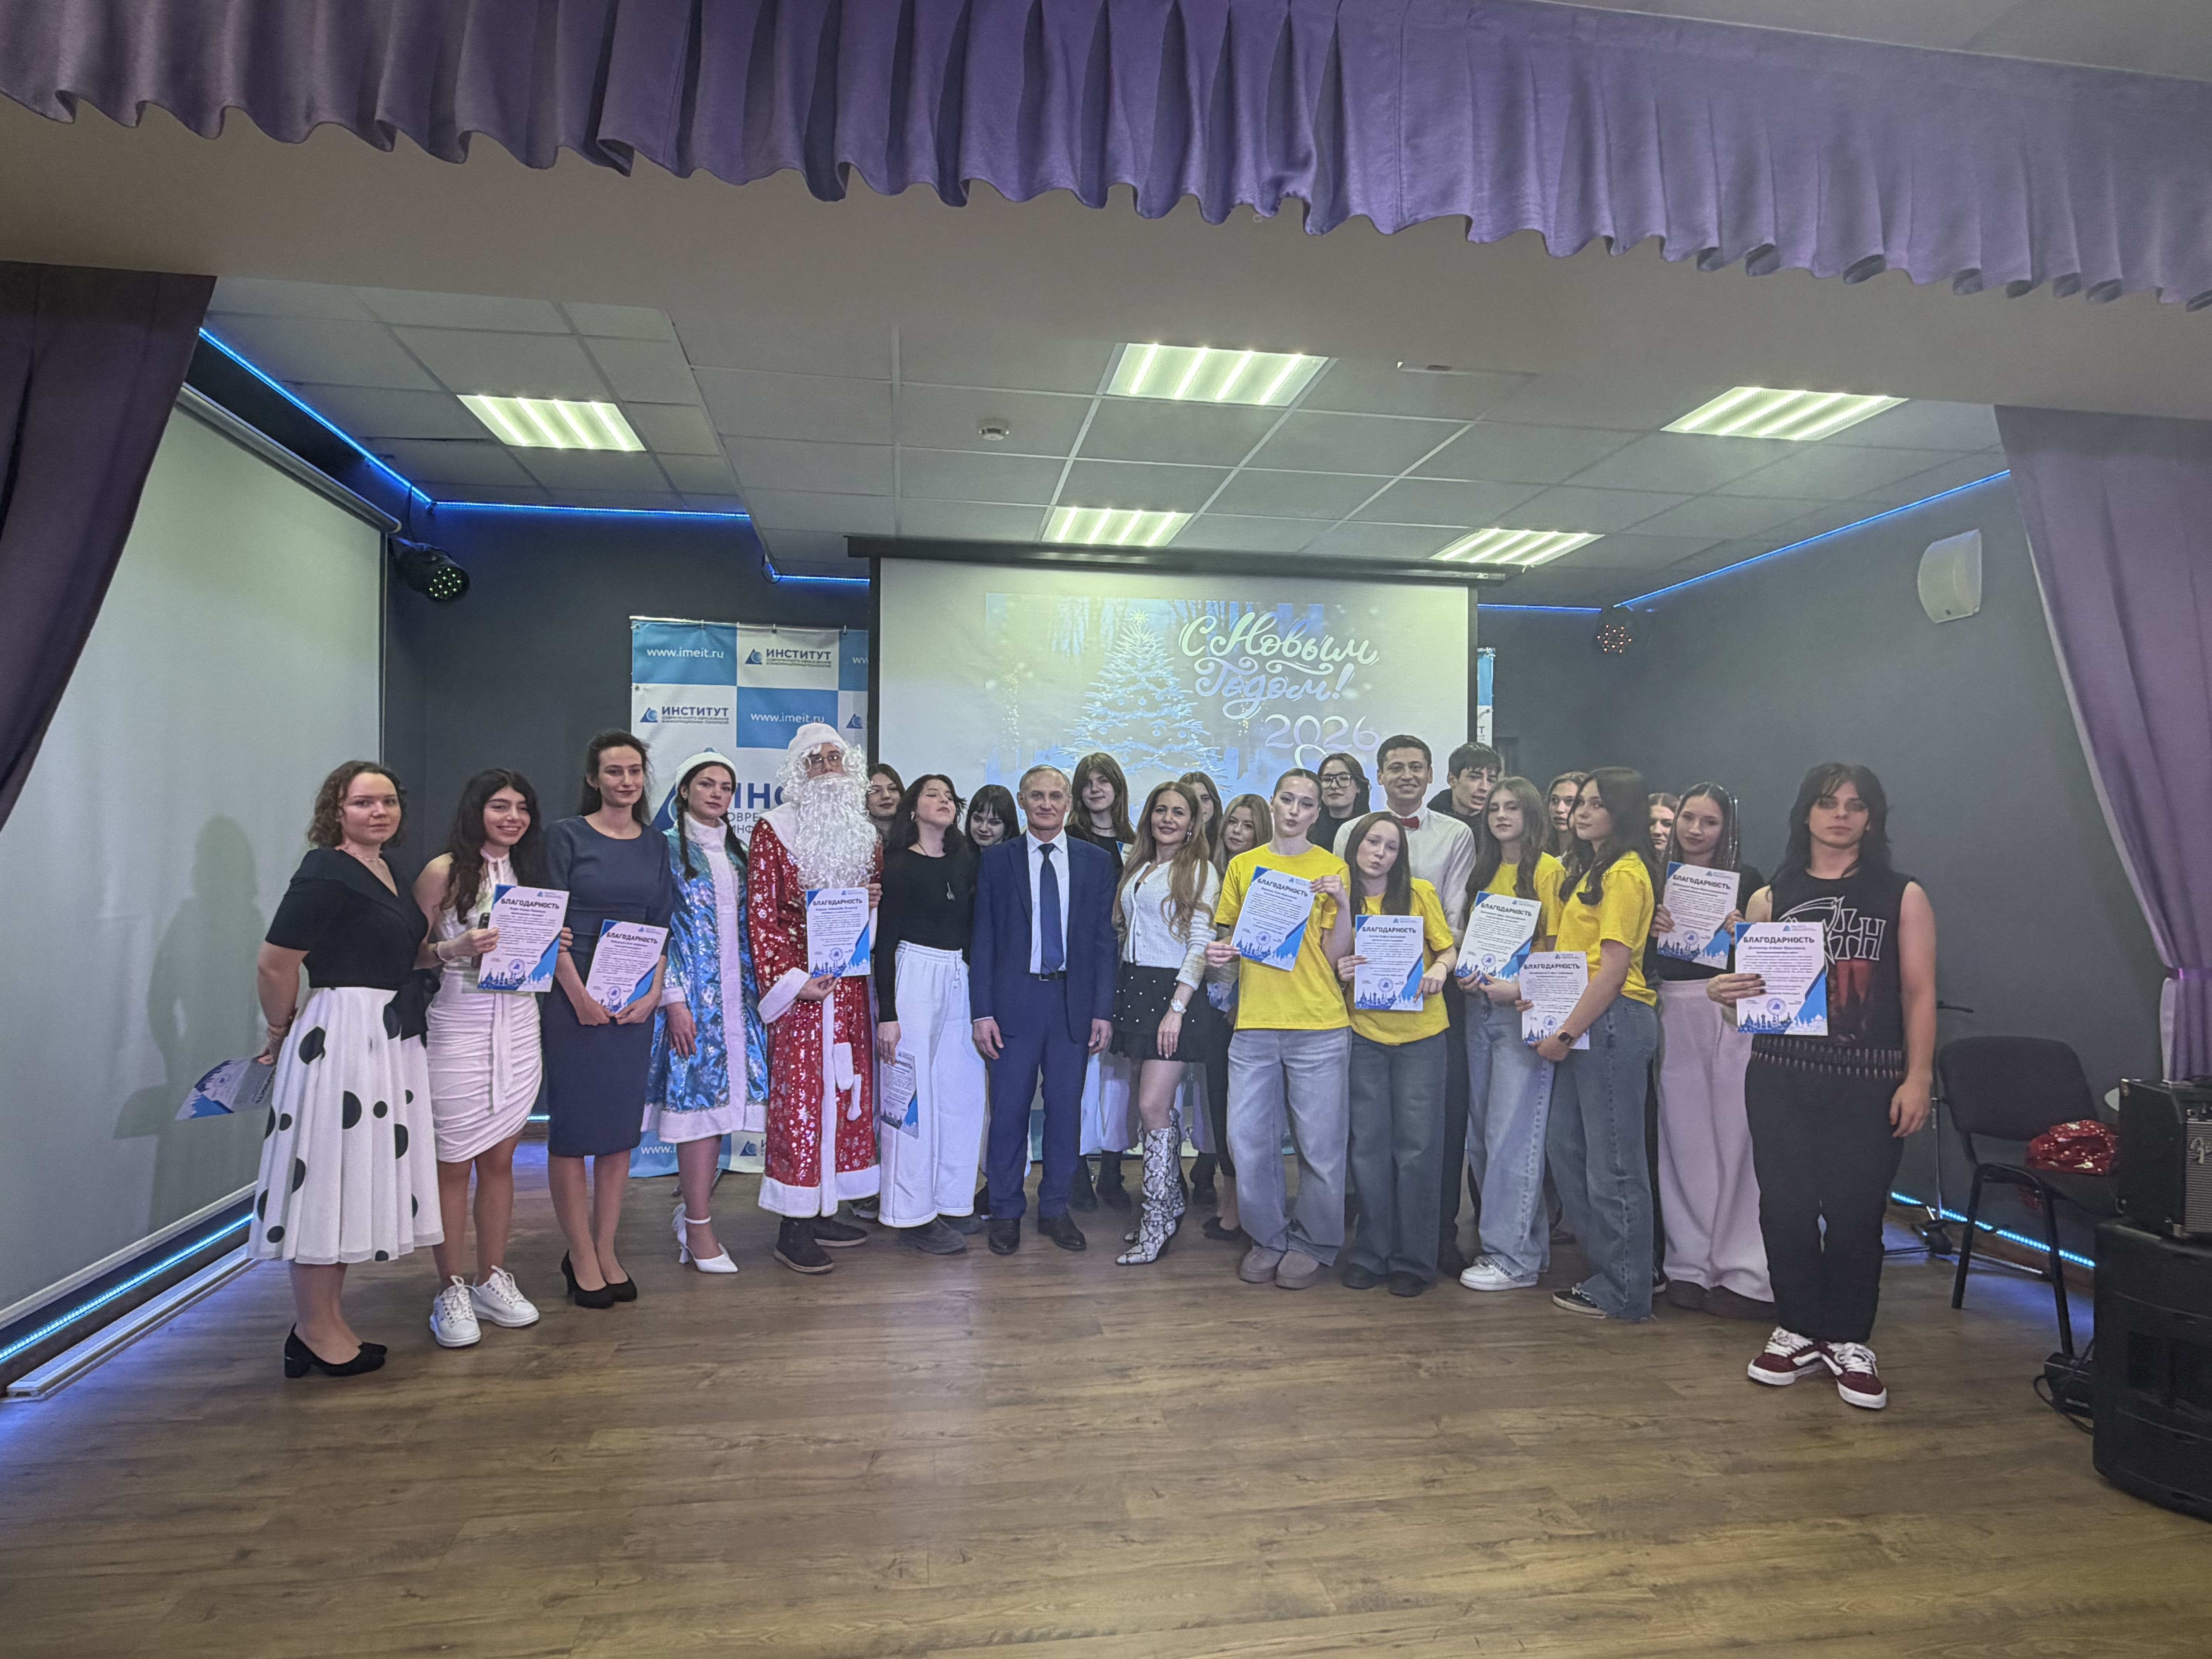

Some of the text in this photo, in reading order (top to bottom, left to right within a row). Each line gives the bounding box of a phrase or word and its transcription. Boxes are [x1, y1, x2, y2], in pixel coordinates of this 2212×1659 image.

[1179, 611, 1378, 665] С Новым
[647, 647, 724, 658] www.imeit.ru
[766, 648, 831, 660] ИНСТИТУТ
[1194, 656, 1355, 720] Годом!
[662, 706, 729, 717] ИНСТИТУТ
[750, 712, 824, 723] www.imeit.ru
[1264, 714, 1381, 751] 2026
[1673, 874, 1731, 890] БЛАГОДАРНОСТЬ
[501, 898, 560, 909] БЛАГОДАРНОСТЬ
